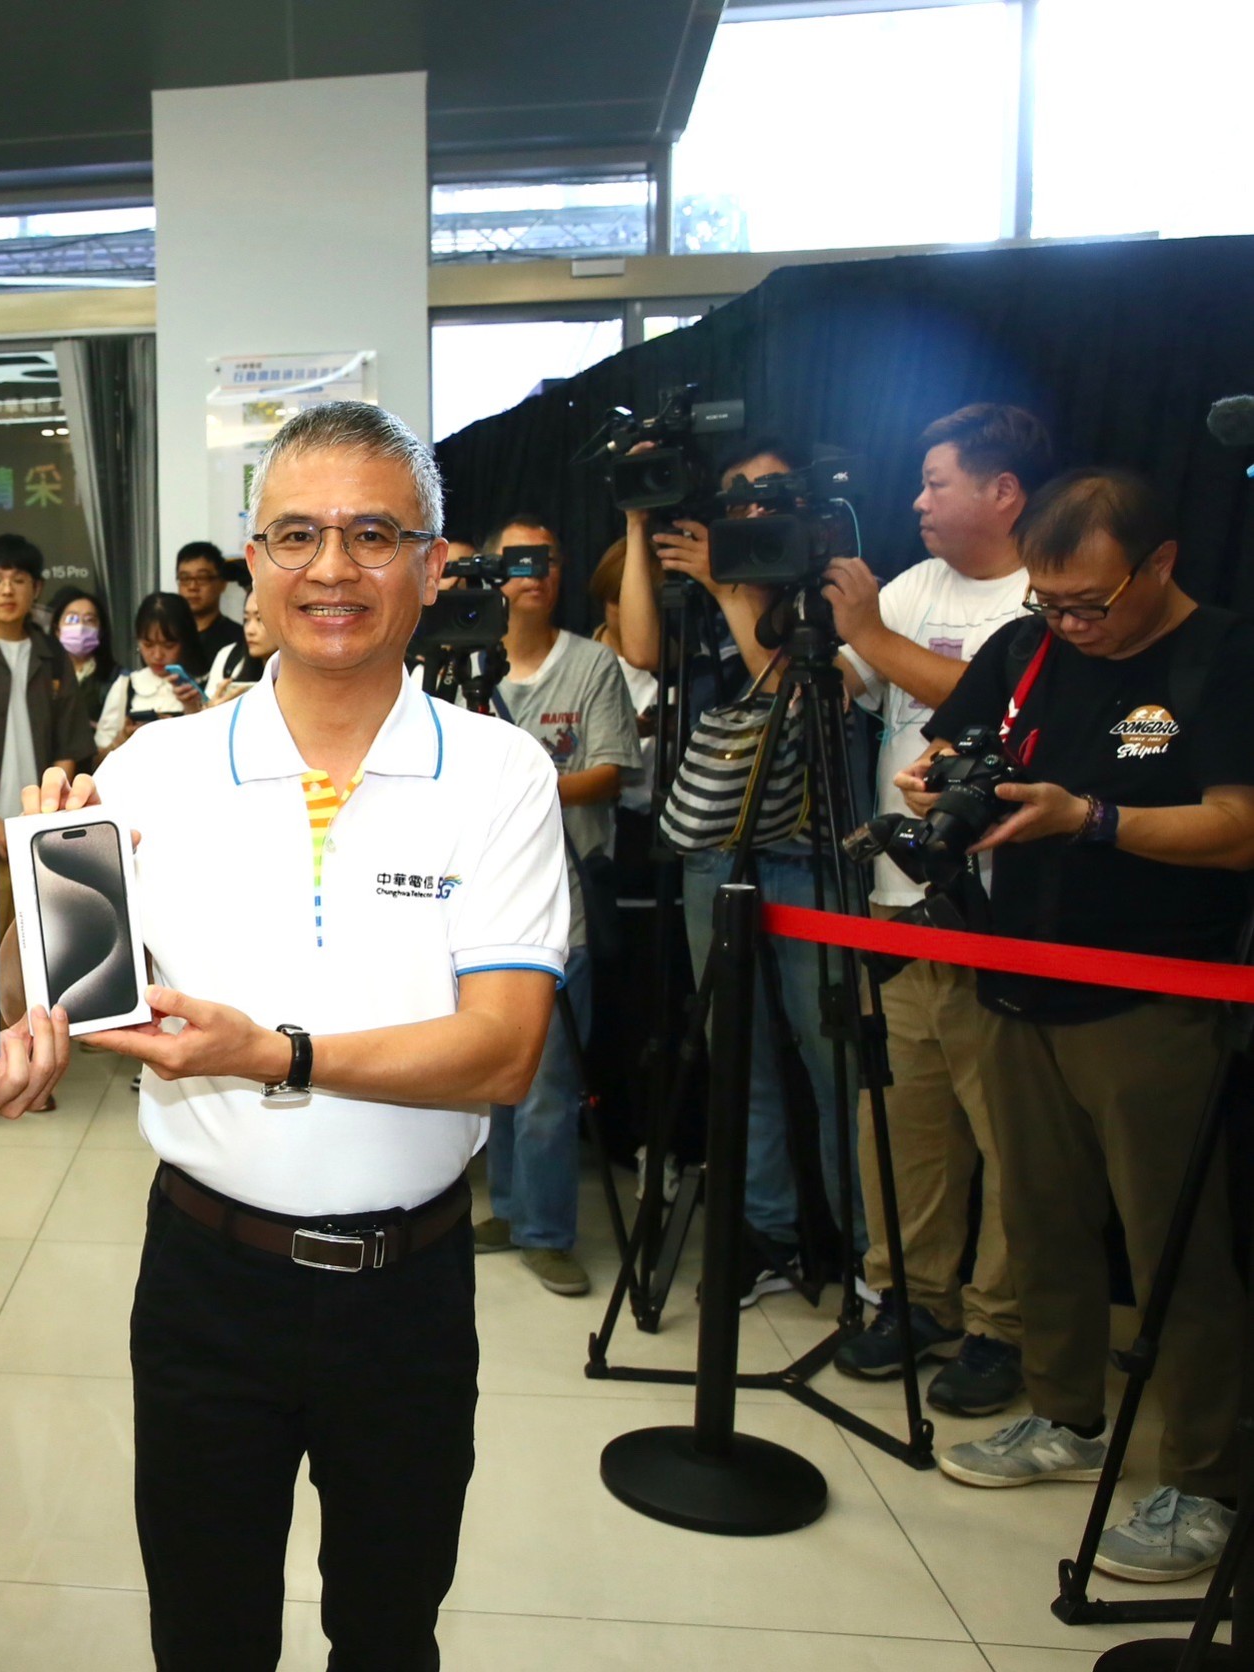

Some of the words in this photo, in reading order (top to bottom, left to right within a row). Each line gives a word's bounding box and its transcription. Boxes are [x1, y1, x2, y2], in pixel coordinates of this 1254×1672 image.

[52, 566, 65, 579] 15
[67, 565, 89, 579] Pro
[376, 872, 434, 890] 中華電信
